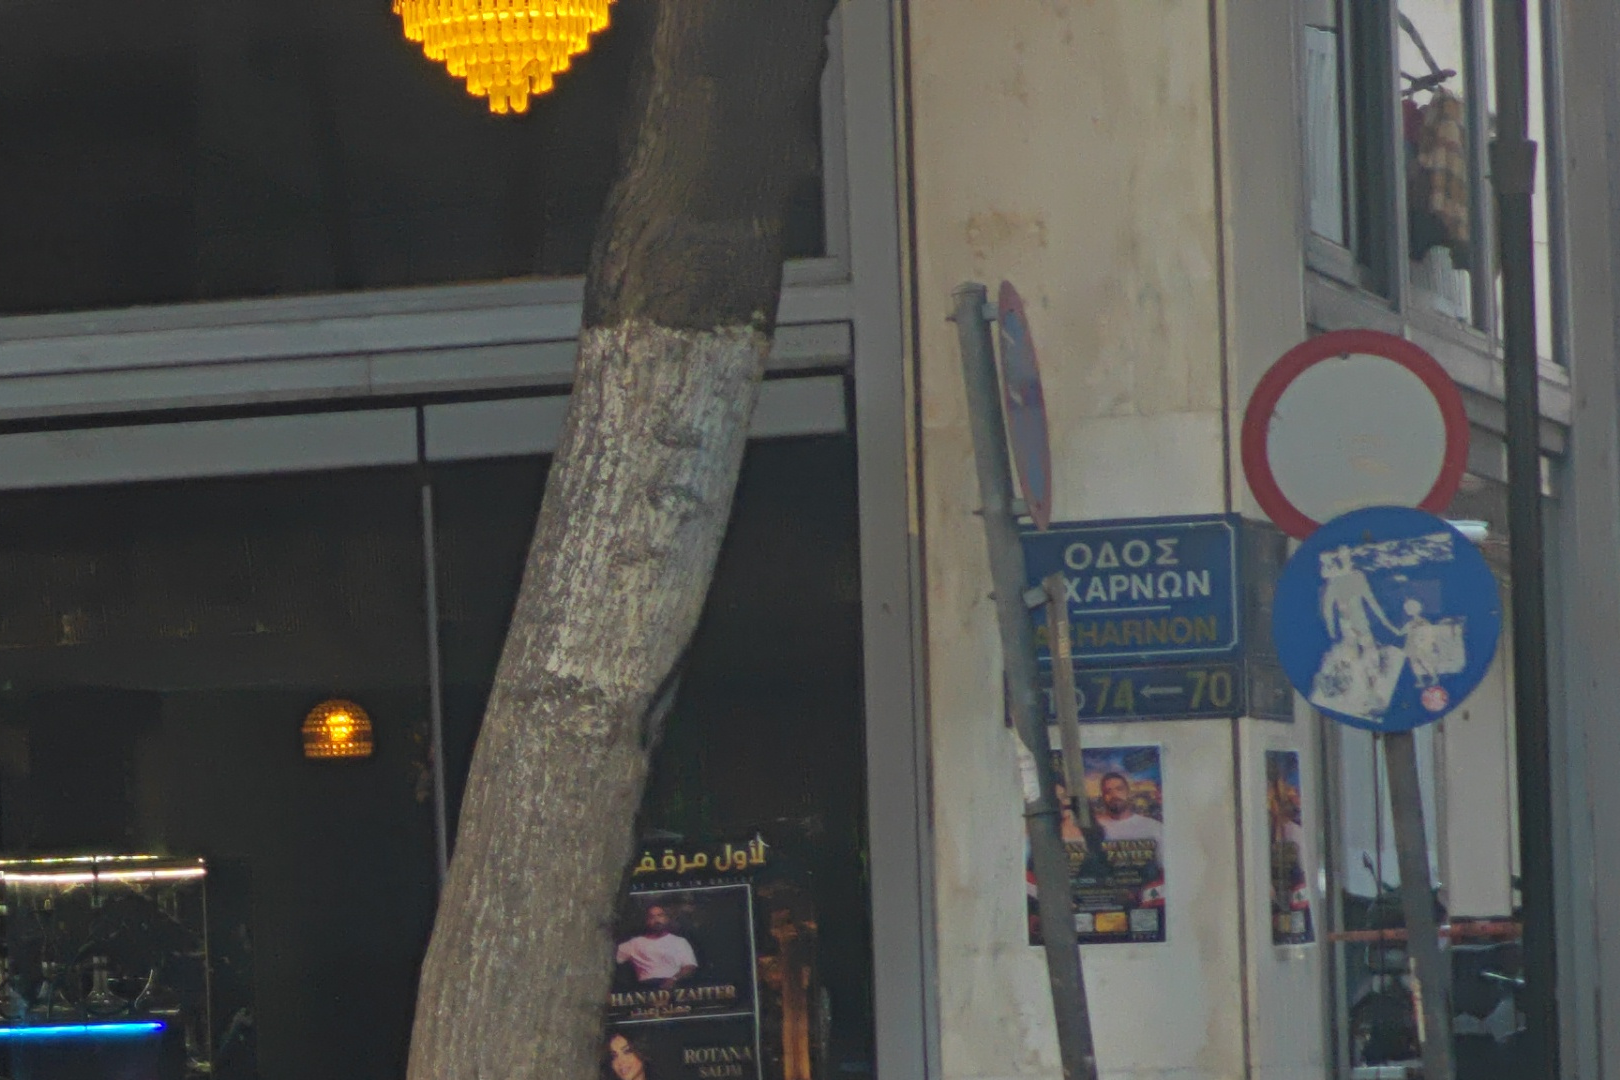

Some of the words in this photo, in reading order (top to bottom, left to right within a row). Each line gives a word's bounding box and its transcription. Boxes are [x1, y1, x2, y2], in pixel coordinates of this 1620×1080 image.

[1063, 538, 1179, 570] ΟΔΟΣ
[1063, 569, 1211, 603] ΧΑΡΝΩΝ
[1035, 615, 1218, 647] AHARNON
[1091, 676, 1136, 714] 74
[1186, 670, 1231, 709] 70
[661, 849, 708, 875] مرة
[713, 838, 766, 872] لأول
[610, 989, 671, 1007] HANAD
